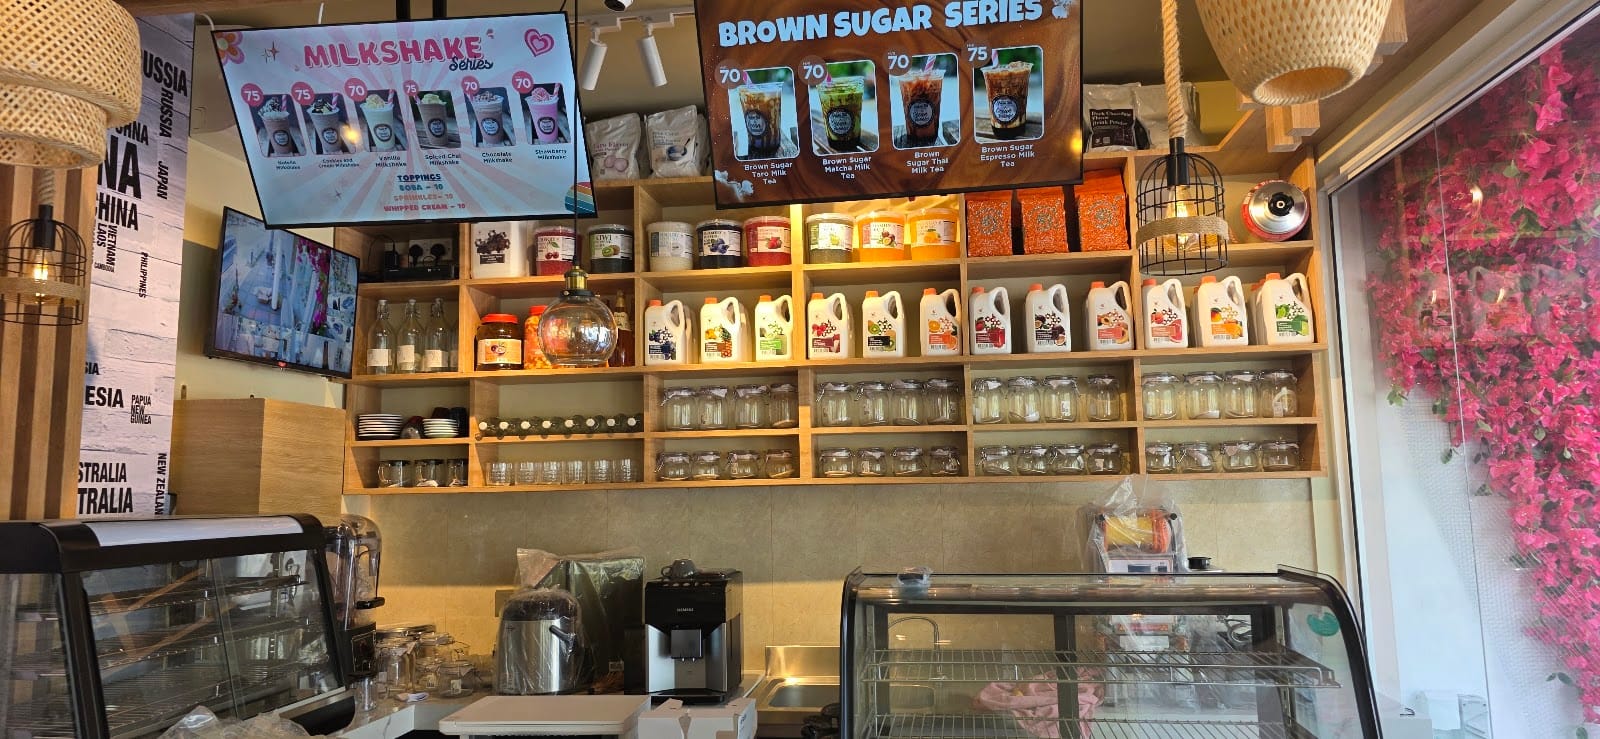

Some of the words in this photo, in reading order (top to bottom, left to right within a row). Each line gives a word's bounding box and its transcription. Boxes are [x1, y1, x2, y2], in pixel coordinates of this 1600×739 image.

[718, 13, 828, 47] BROWN
[833, 4, 932, 38] SUGAR
[944, 0, 1043, 28] SERIES
[304, 36, 483, 68] MILKSHAKE
[449, 56, 494, 71] Series
[967, 46, 988, 62] 75
[887, 54, 910, 70] 70
[719, 69, 741, 84] 70
[803, 64, 825, 80] 70
[405, 85, 417, 93] 75
[464, 81, 477, 90] 70
[515, 78, 531, 89] 70
[243, 90, 261, 102] 75
[295, 89, 311, 100] 75
[348, 85, 366, 97] 70
[159, 87, 174, 138] RUSSIA
[981, 145, 1008, 153] Brown
[1009, 144, 1033, 152] Sugar
[822, 157, 847, 165] Brown
[849, 155, 872, 165] Sugar
[914, 151, 940, 159] Brown
[980, 153, 1016, 162] Espresso
[1018, 151, 1035, 159] Milk
[744, 163, 769, 171] Brown
[770, 162, 793, 170] Sugar
[824, 165, 852, 173] Matcha
[854, 163, 870, 171] Milk
[906, 159, 930, 168] Sugar
[771, 169, 787, 177] Milk
[911, 166, 927, 174] Milk
[157, 160, 169, 200] JAPAN
[397, 173, 441, 182] TOPPINGS
[840, 172, 855, 180] Tea
[96, 223, 107, 248] LAOS
[106, 224, 118, 266] VIETNAM
[138, 252, 149, 298] PHILIPPINES
[84, 385, 124, 408] ESIA
[131, 394, 152, 406] PAPUA
[130, 405, 146, 416] NEW
[130, 414, 152, 425] GUINEA
[156, 453, 168, 475] NEW
